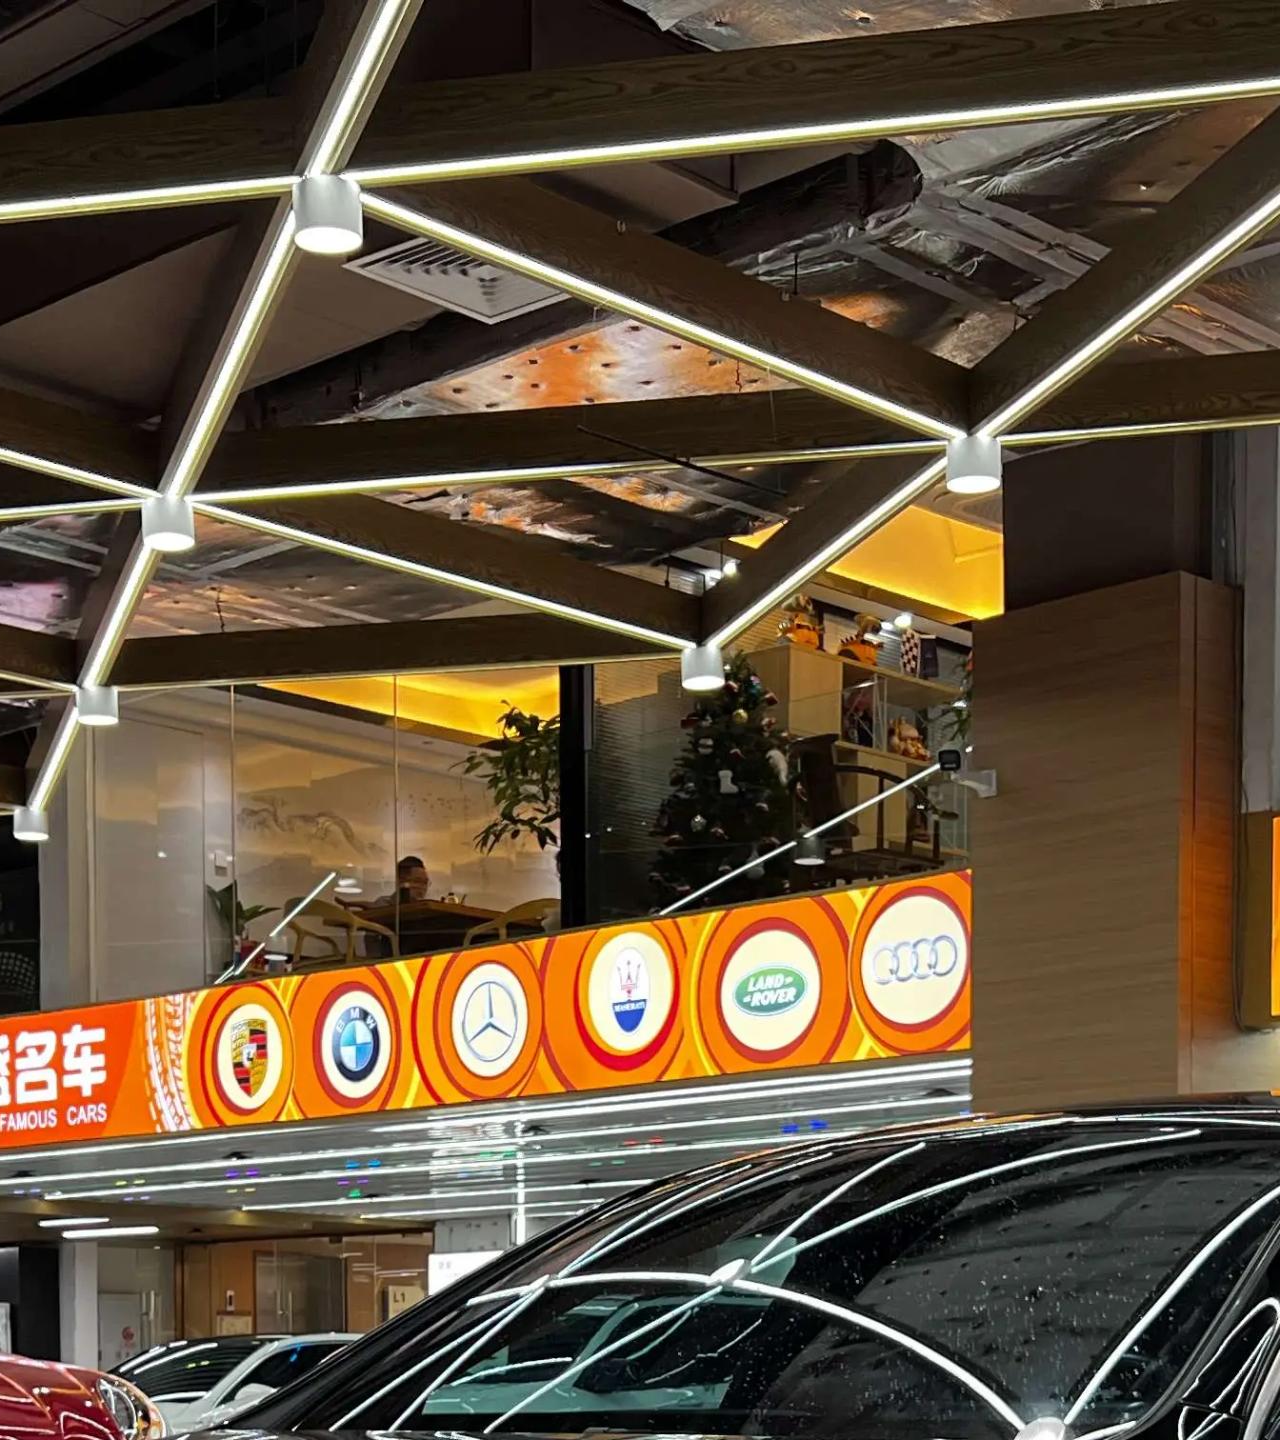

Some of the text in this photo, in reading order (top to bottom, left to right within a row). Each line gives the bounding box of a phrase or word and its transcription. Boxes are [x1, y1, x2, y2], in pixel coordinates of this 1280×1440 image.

[747, 973, 784, 992] LAND
[751, 987, 797, 1007] ROVER
[336, 1007, 377, 1033] BMW
[66, 1103, 107, 1126] CARS
